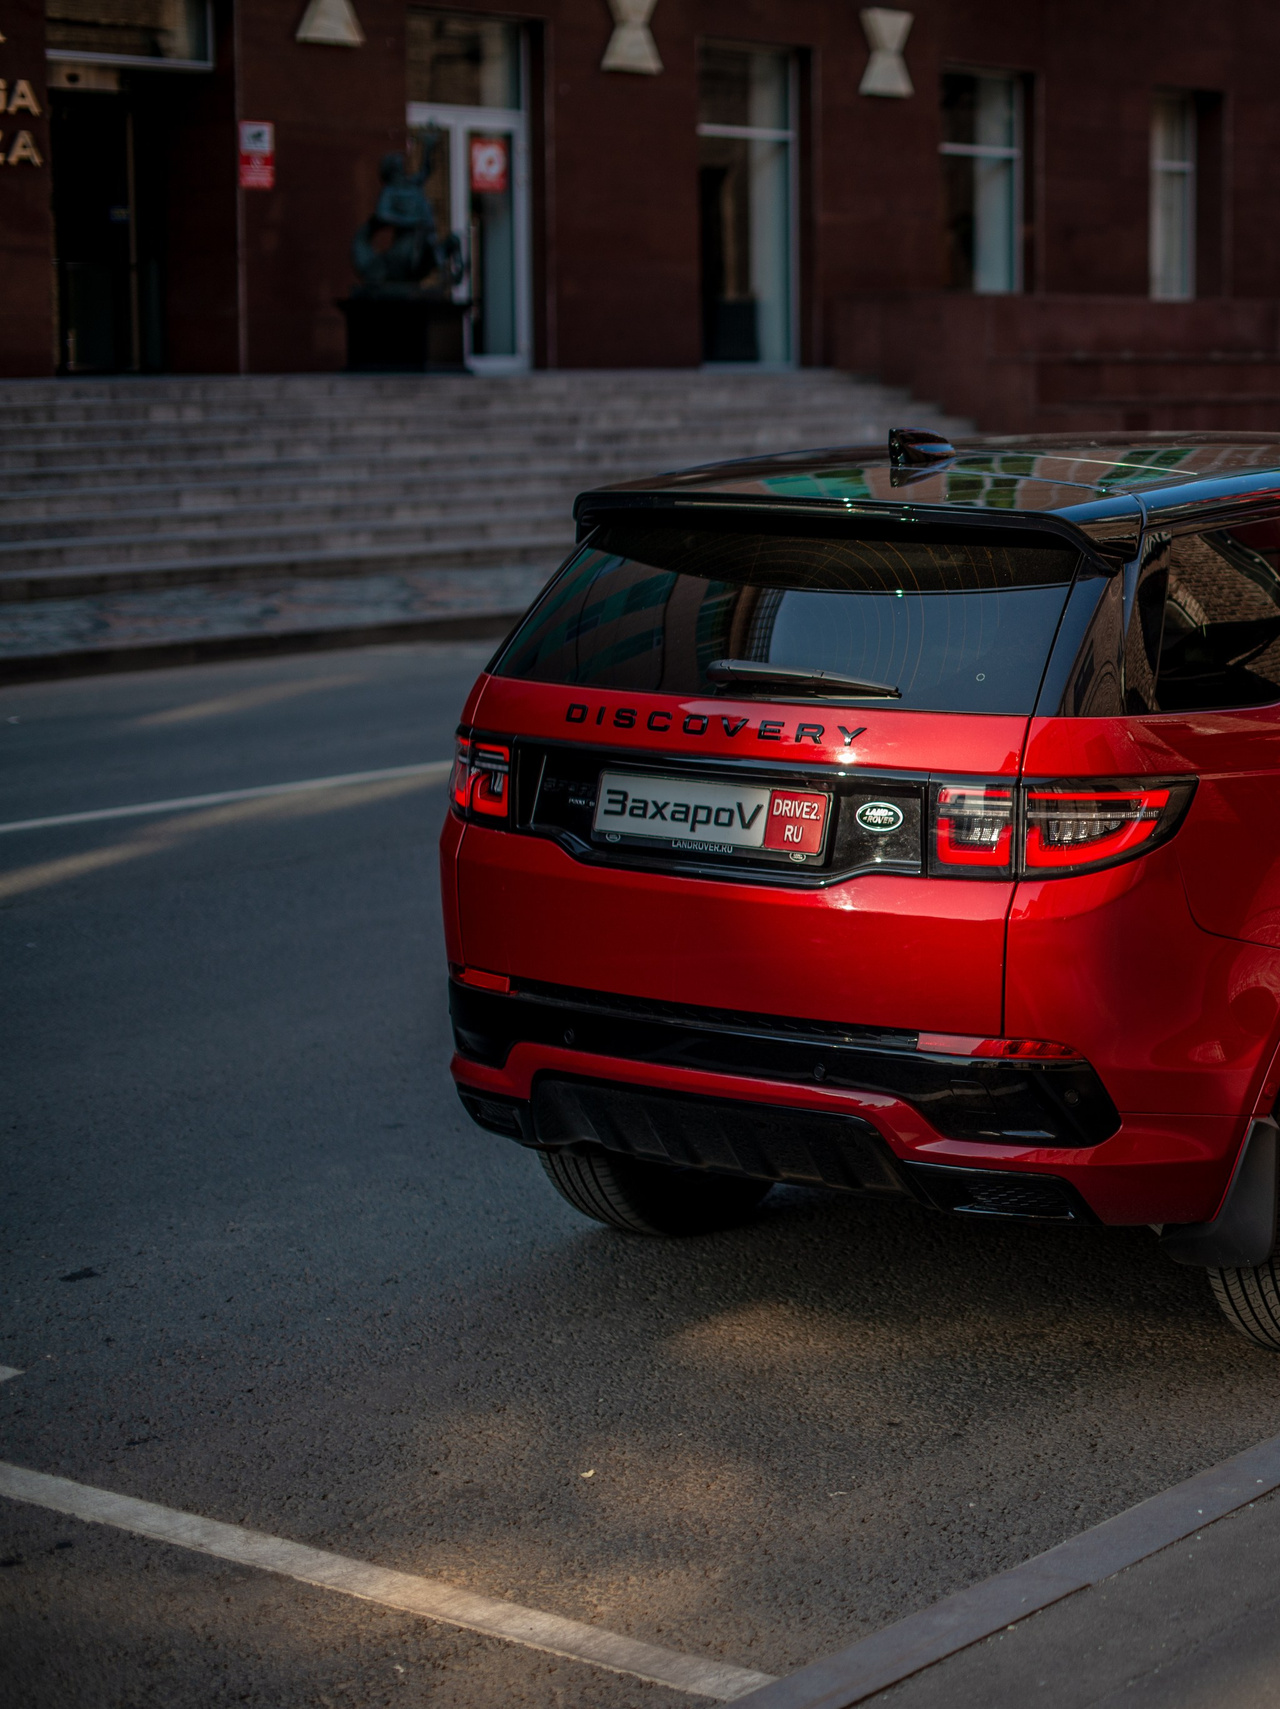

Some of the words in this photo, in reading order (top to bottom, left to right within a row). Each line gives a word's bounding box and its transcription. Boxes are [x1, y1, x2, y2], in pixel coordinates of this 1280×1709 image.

[565, 703, 867, 746] DISCOVERY
[865, 808, 889, 816] LAND
[866, 815, 894, 824] ROVER
[784, 825, 802, 843] RU
[671, 840, 733, 853] LANDROVER.RU
